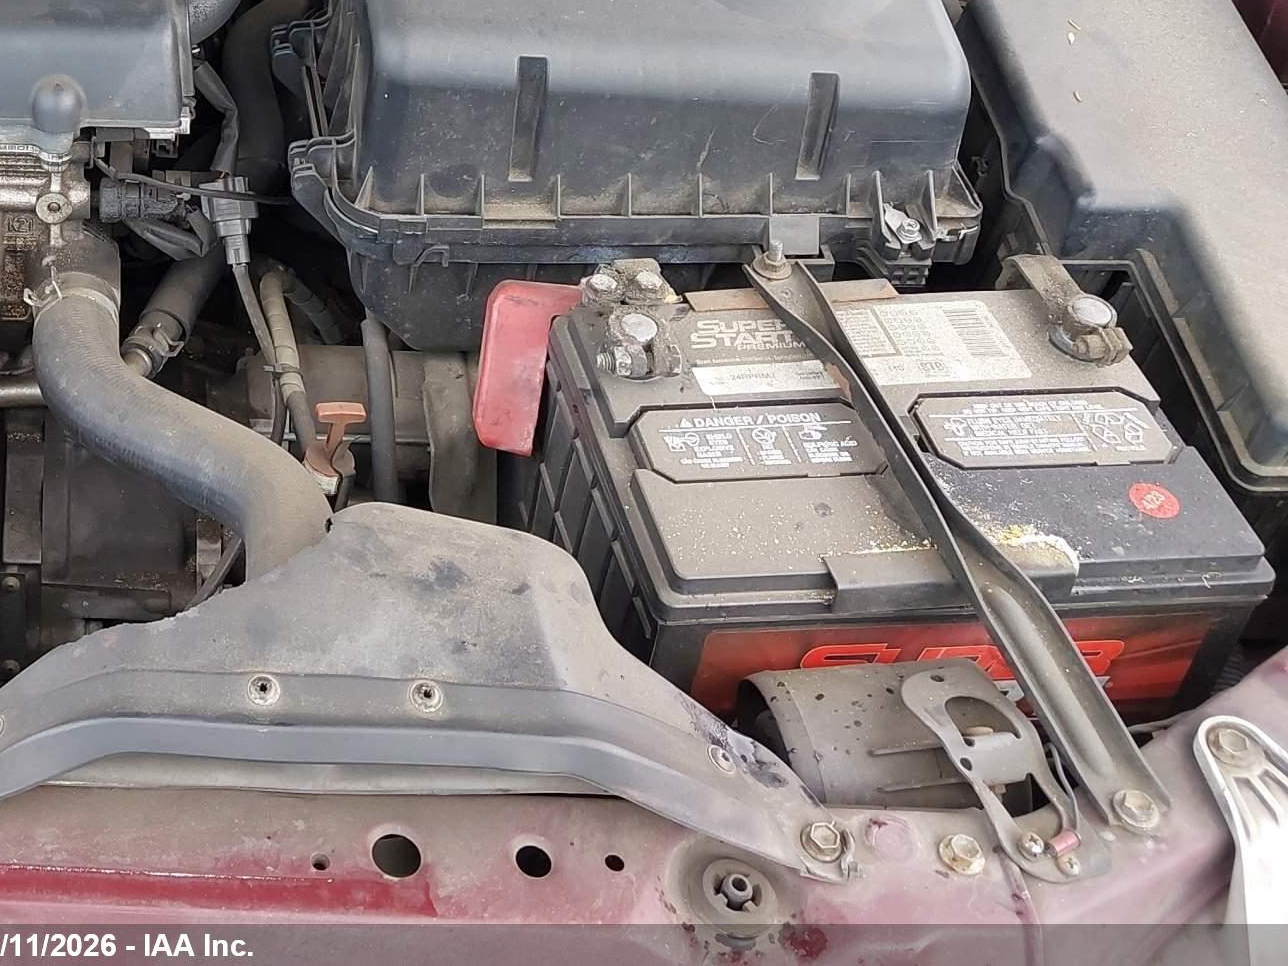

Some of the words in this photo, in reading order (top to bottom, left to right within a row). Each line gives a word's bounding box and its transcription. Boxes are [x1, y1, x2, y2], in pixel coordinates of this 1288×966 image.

[690, 330, 794, 349] START
[737, 341, 807, 351] PREMIUM
[693, 416, 755, 428] DANGER
[768, 412, 822, 424] POISON
